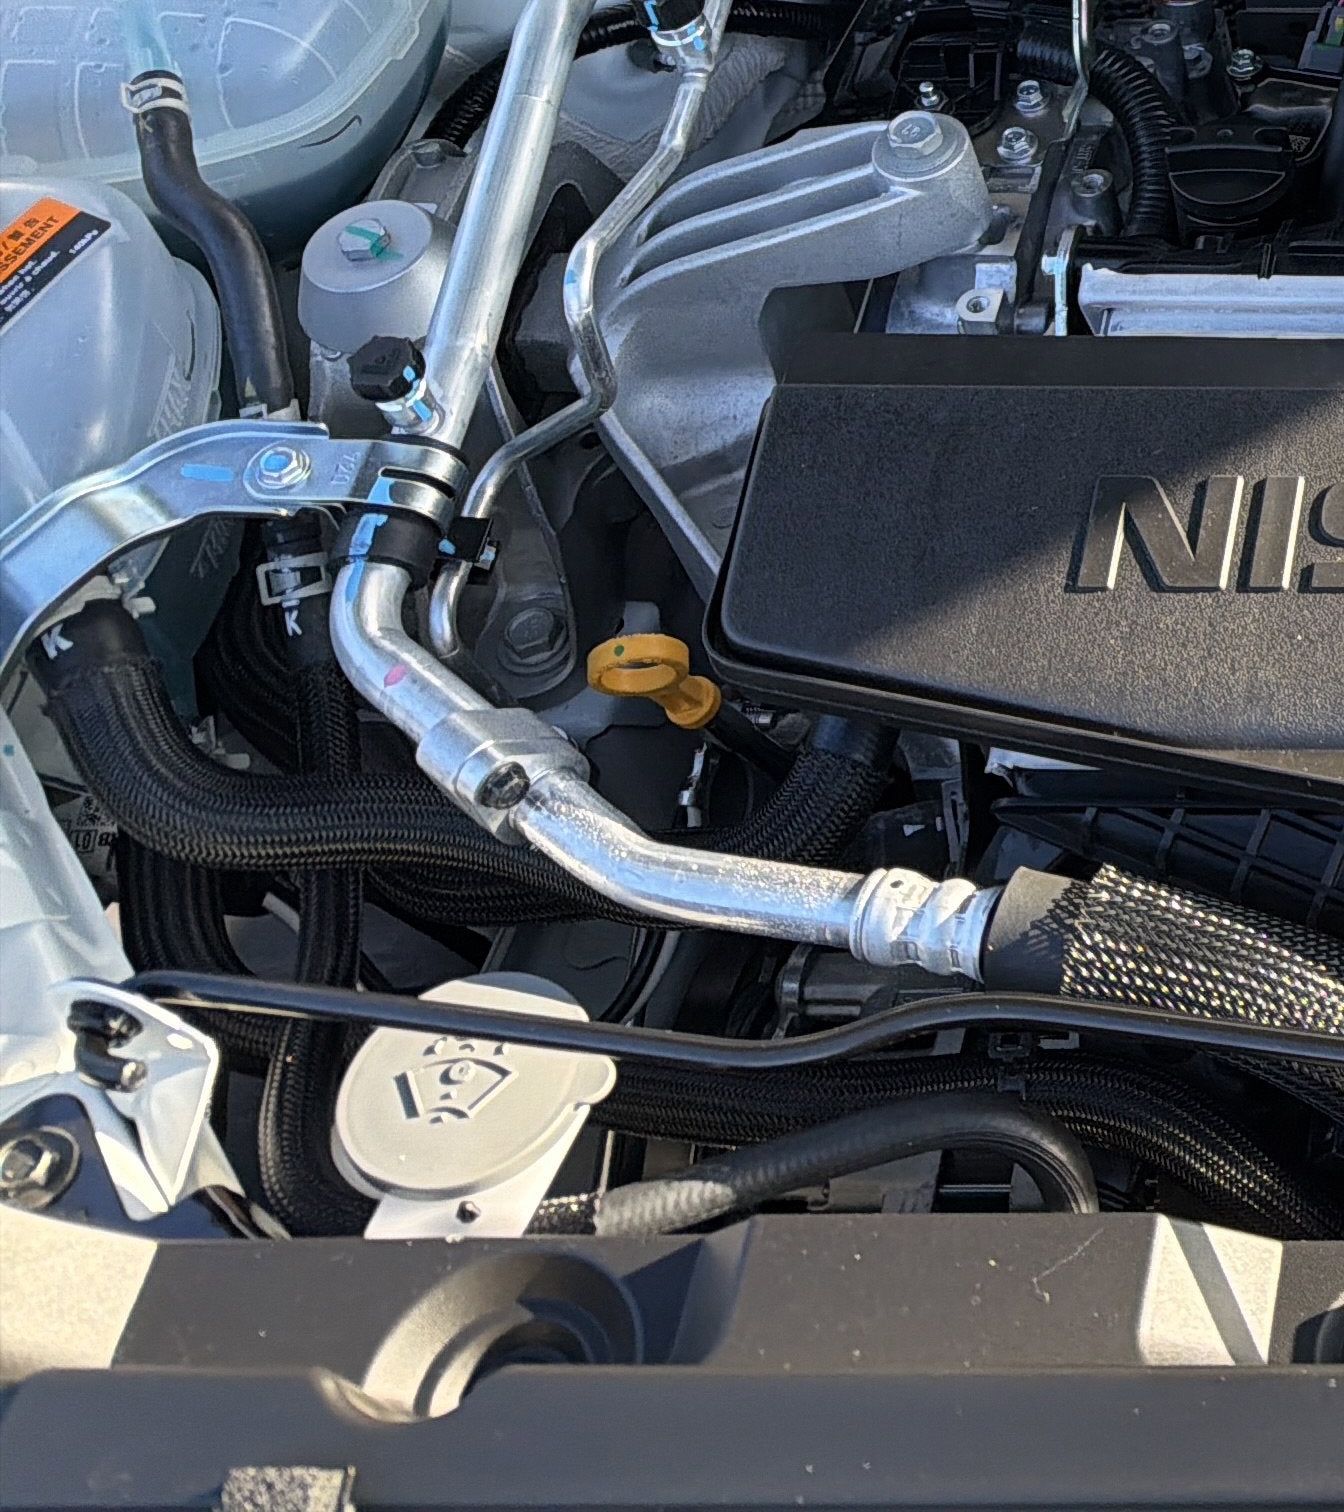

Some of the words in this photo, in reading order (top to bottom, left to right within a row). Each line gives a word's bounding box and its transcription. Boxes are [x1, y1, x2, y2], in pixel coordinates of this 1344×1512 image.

[0, 216, 59, 272] SSEMENT
[41, 623, 74, 660] K
[284, 609, 302, 637] K
